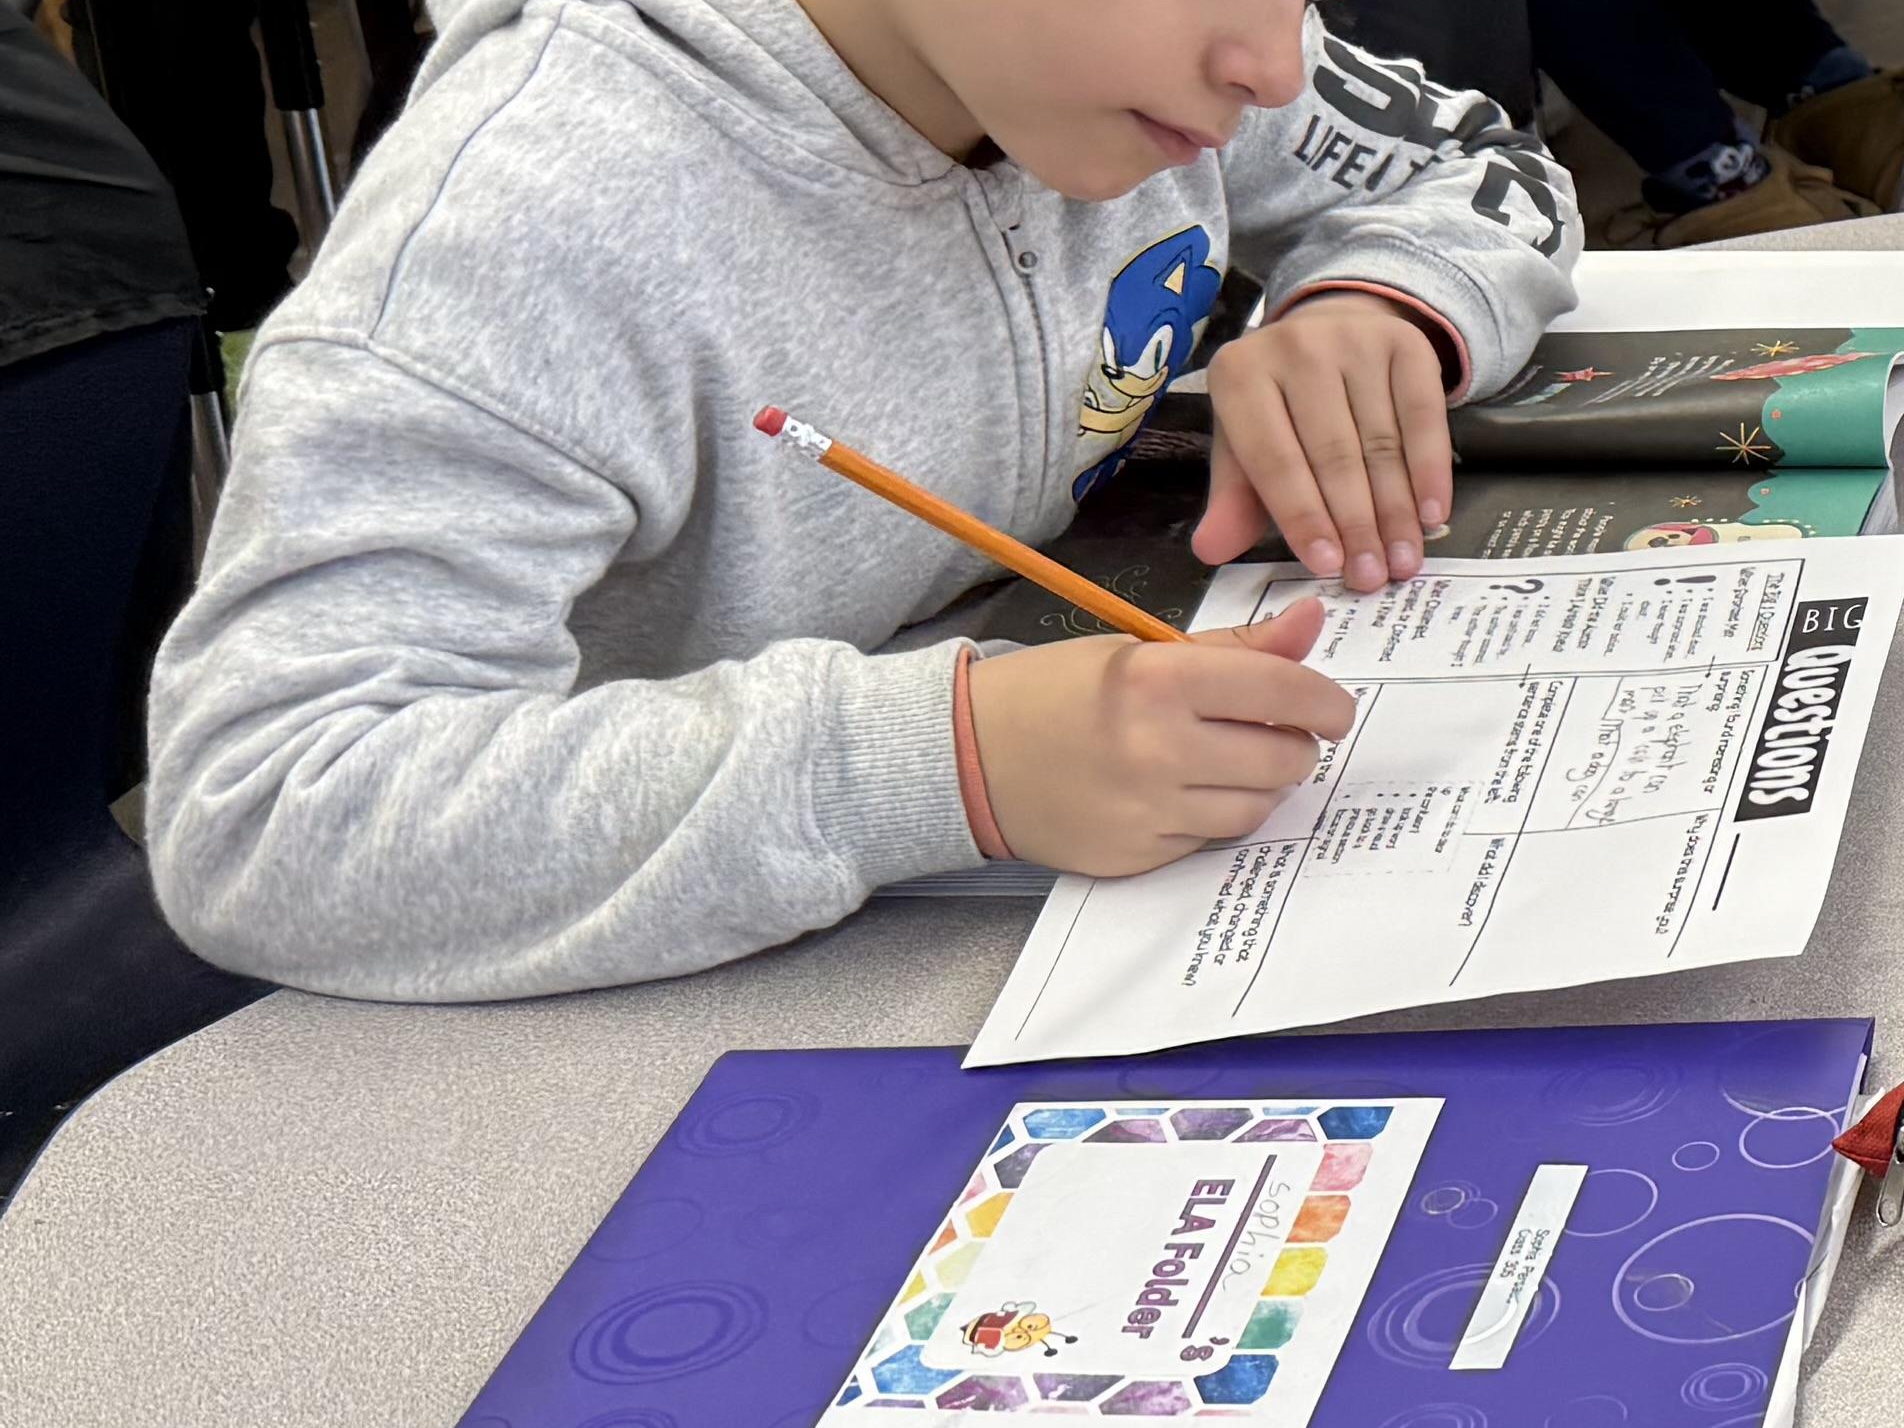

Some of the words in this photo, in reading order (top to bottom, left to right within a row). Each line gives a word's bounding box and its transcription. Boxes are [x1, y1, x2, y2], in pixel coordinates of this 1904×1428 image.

[1801, 603, 1865, 635] BIG
[1747, 644, 1858, 806] Questions
[1171, 1178, 1234, 1235] ELA
[1221, 1179, 1293, 1293] Sophia
[1122, 1242, 1202, 1338] Folder
